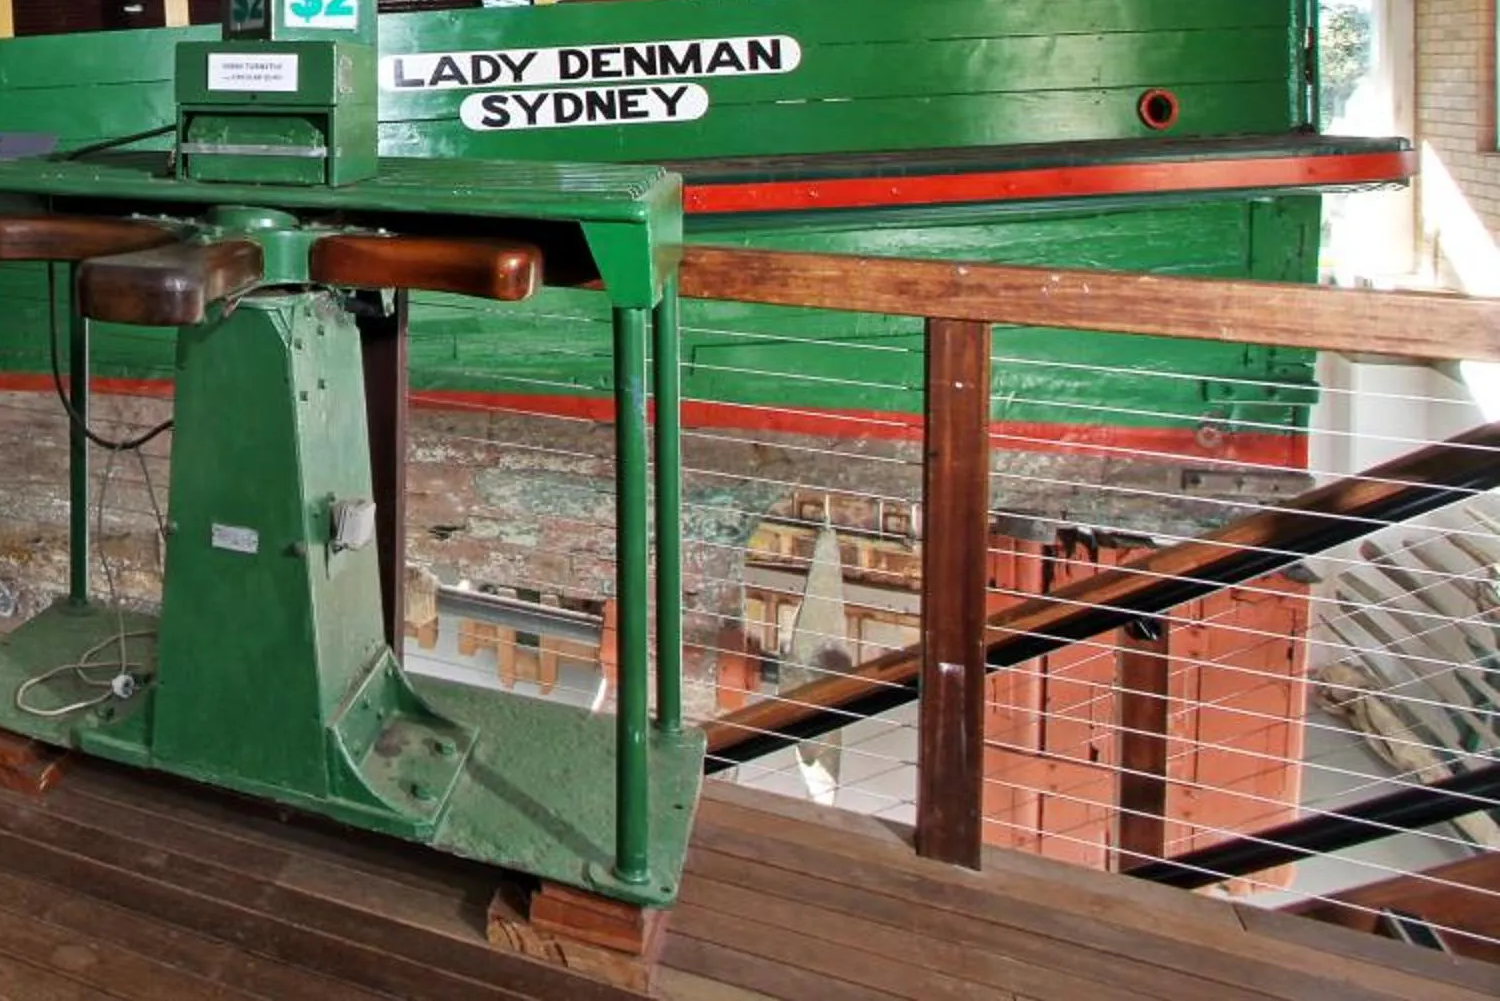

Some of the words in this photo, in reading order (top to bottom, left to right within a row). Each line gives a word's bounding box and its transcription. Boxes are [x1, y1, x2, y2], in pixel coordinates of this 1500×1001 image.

[394, 52, 538, 88] LADY
[558, 39, 782, 81] DENMAN
[481, 86, 688, 128] SYDNEY
